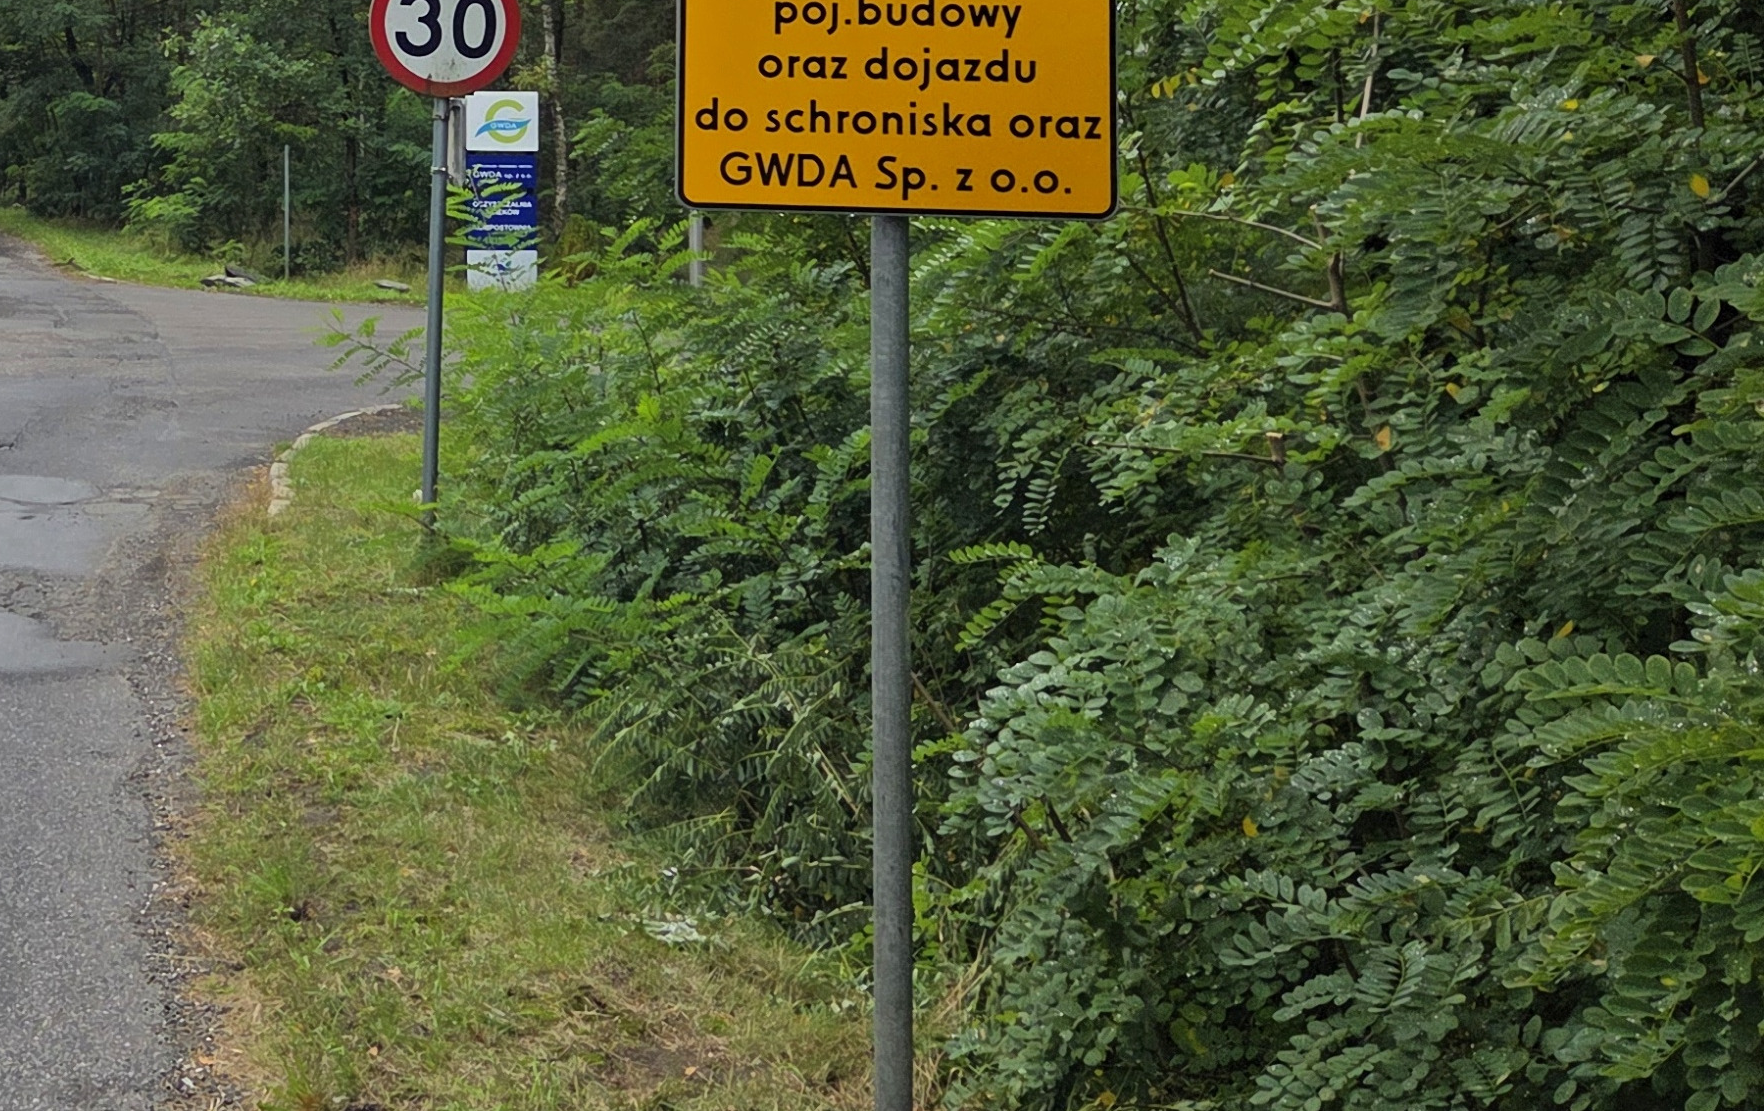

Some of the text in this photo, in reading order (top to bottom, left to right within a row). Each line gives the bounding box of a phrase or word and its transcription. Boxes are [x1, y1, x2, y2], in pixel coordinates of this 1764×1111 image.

[758, 46, 1037, 92] oraz dojazdu
[695, 97, 1102, 140] do schroniska oraz
[472, 170, 502, 178] GWDA
[720, 151, 1072, 201] GWDA Sp. z o.o.
